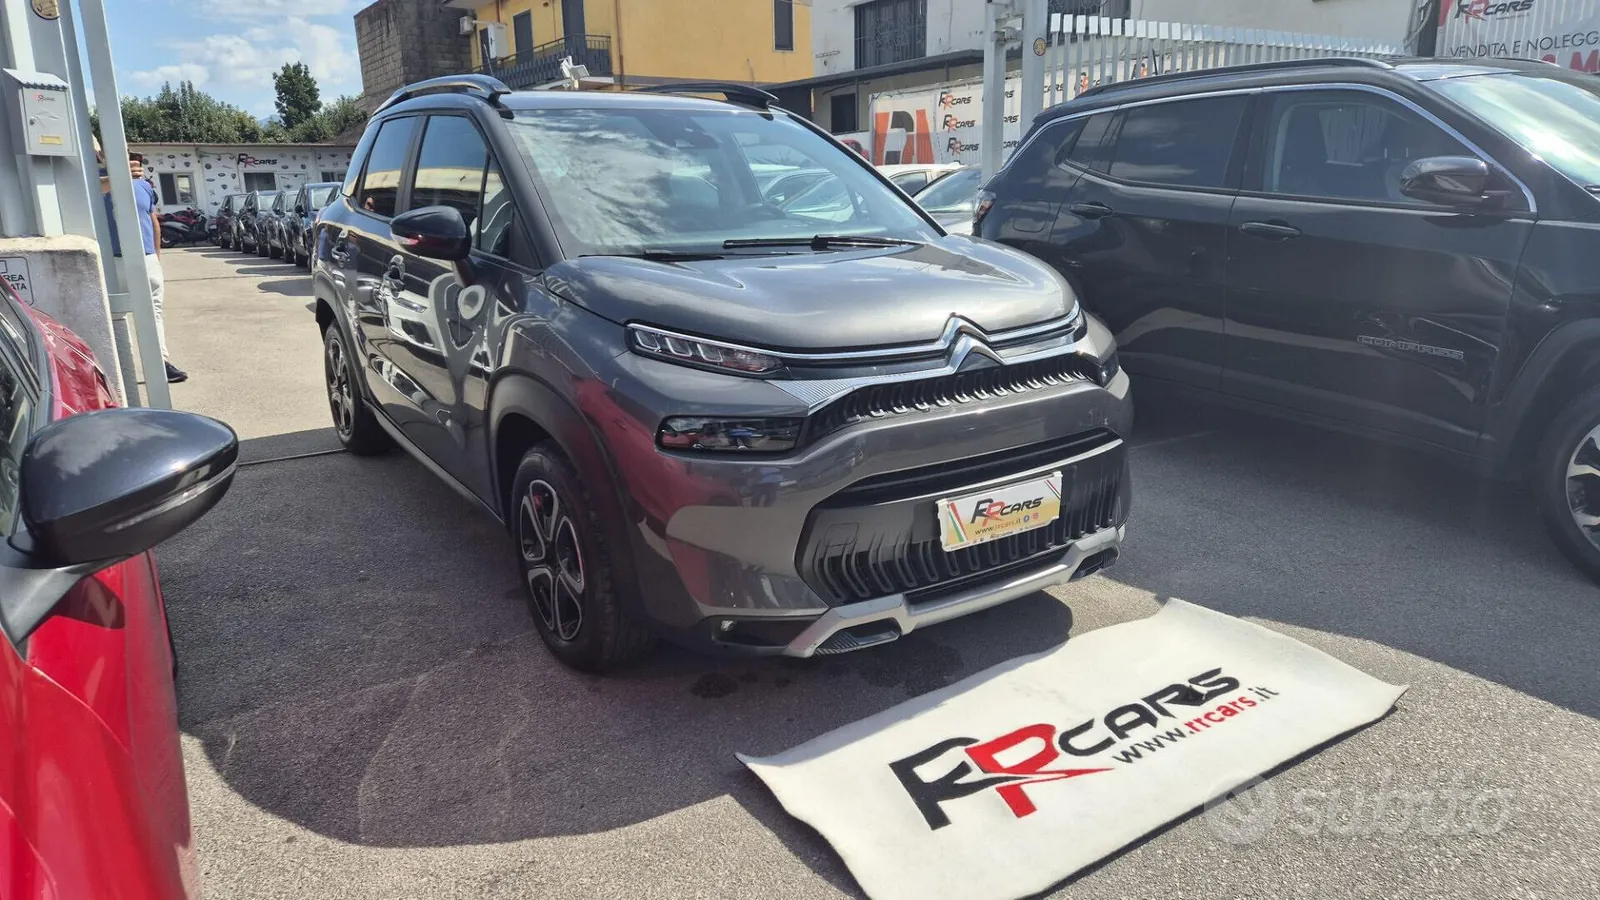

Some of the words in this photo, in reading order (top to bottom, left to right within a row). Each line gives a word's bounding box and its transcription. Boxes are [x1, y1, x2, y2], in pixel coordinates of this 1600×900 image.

[1450, 42, 1507, 58] VENDITA
[1513, 40, 1522, 54] E
[1526, 30, 1600, 52] NOLEGG
[2, 274, 26, 282] REA
[974, 518, 1021, 535] www.rrcars.it
[1112, 685, 1280, 764] www.rrcars.it
